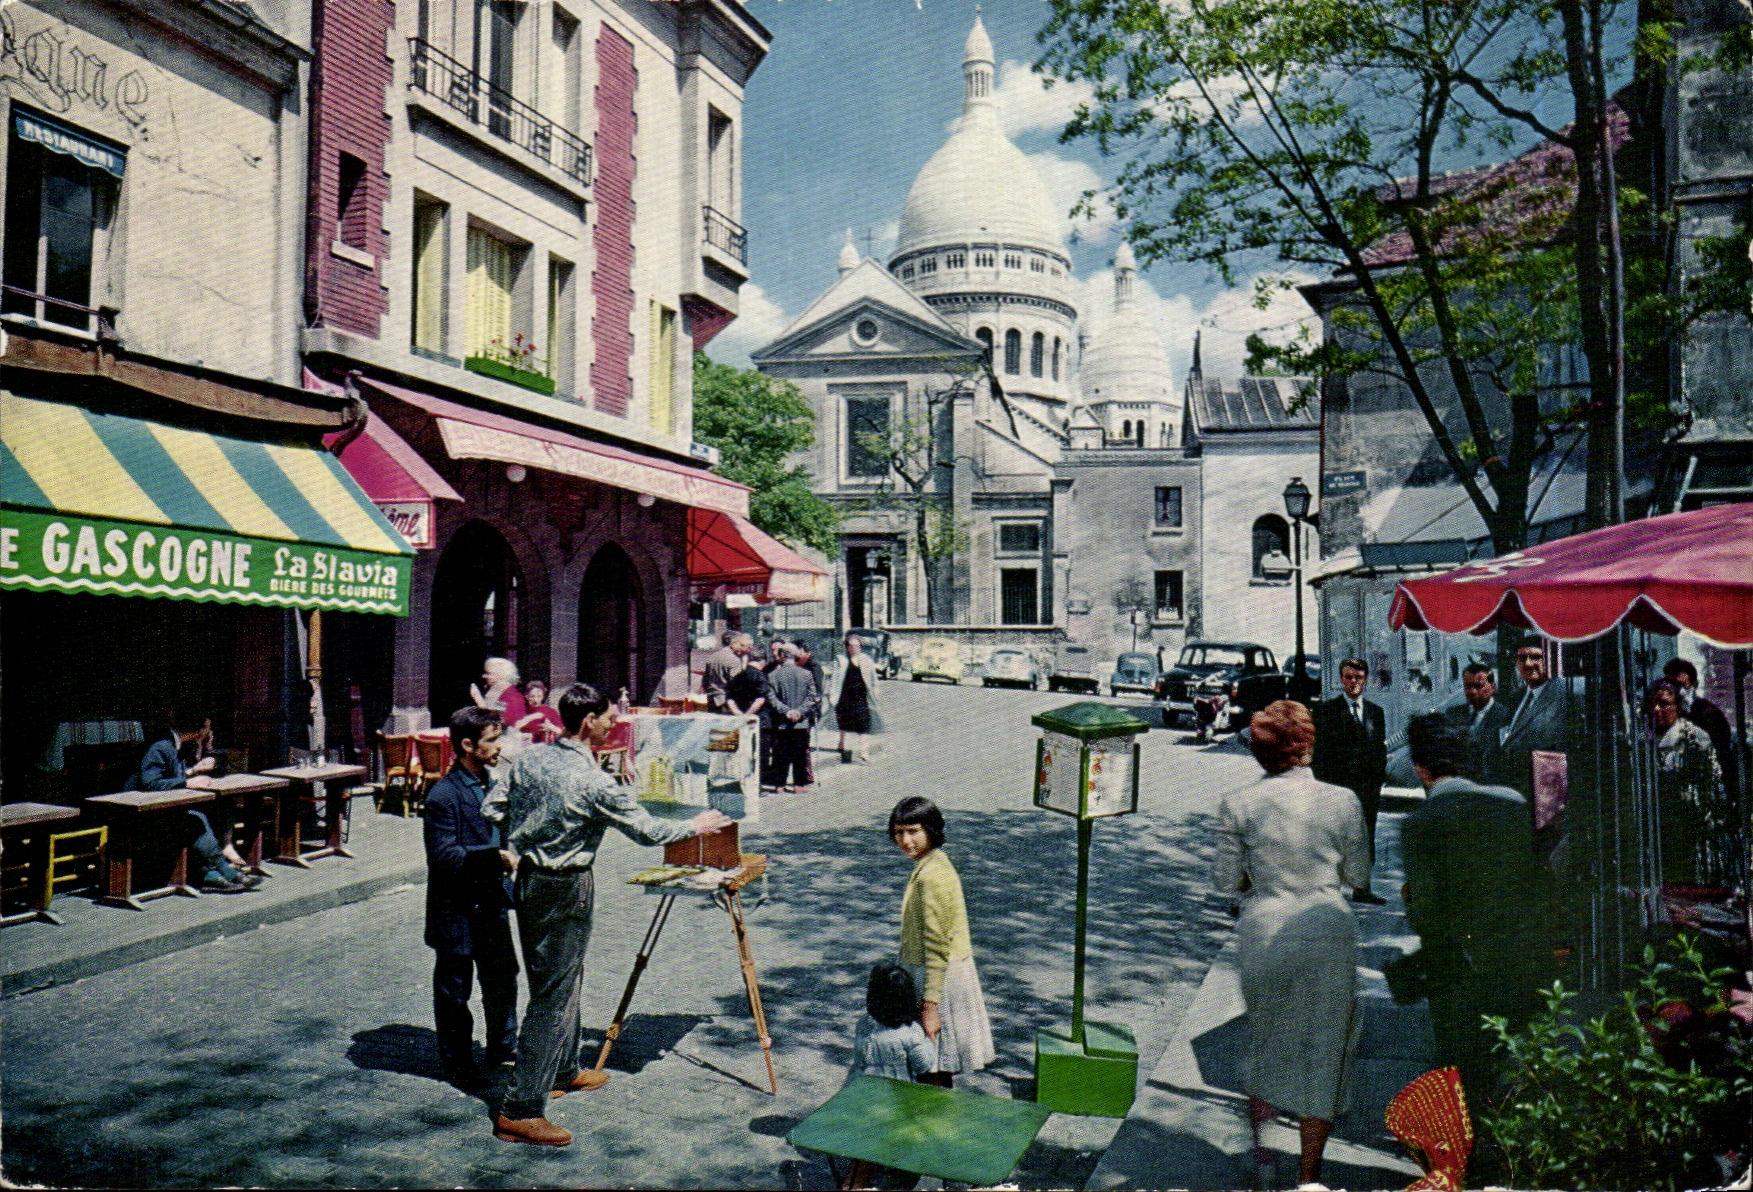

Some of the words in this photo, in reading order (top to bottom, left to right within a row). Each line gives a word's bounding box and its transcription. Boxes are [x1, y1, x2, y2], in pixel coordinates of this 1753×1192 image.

[42, 522, 252, 588] GASCOGNE
[273, 547, 308, 579] La
[311, 551, 398, 587] Slavia
[311, 581, 335, 595] DES
[338, 584, 397, 600] GOURMETS
